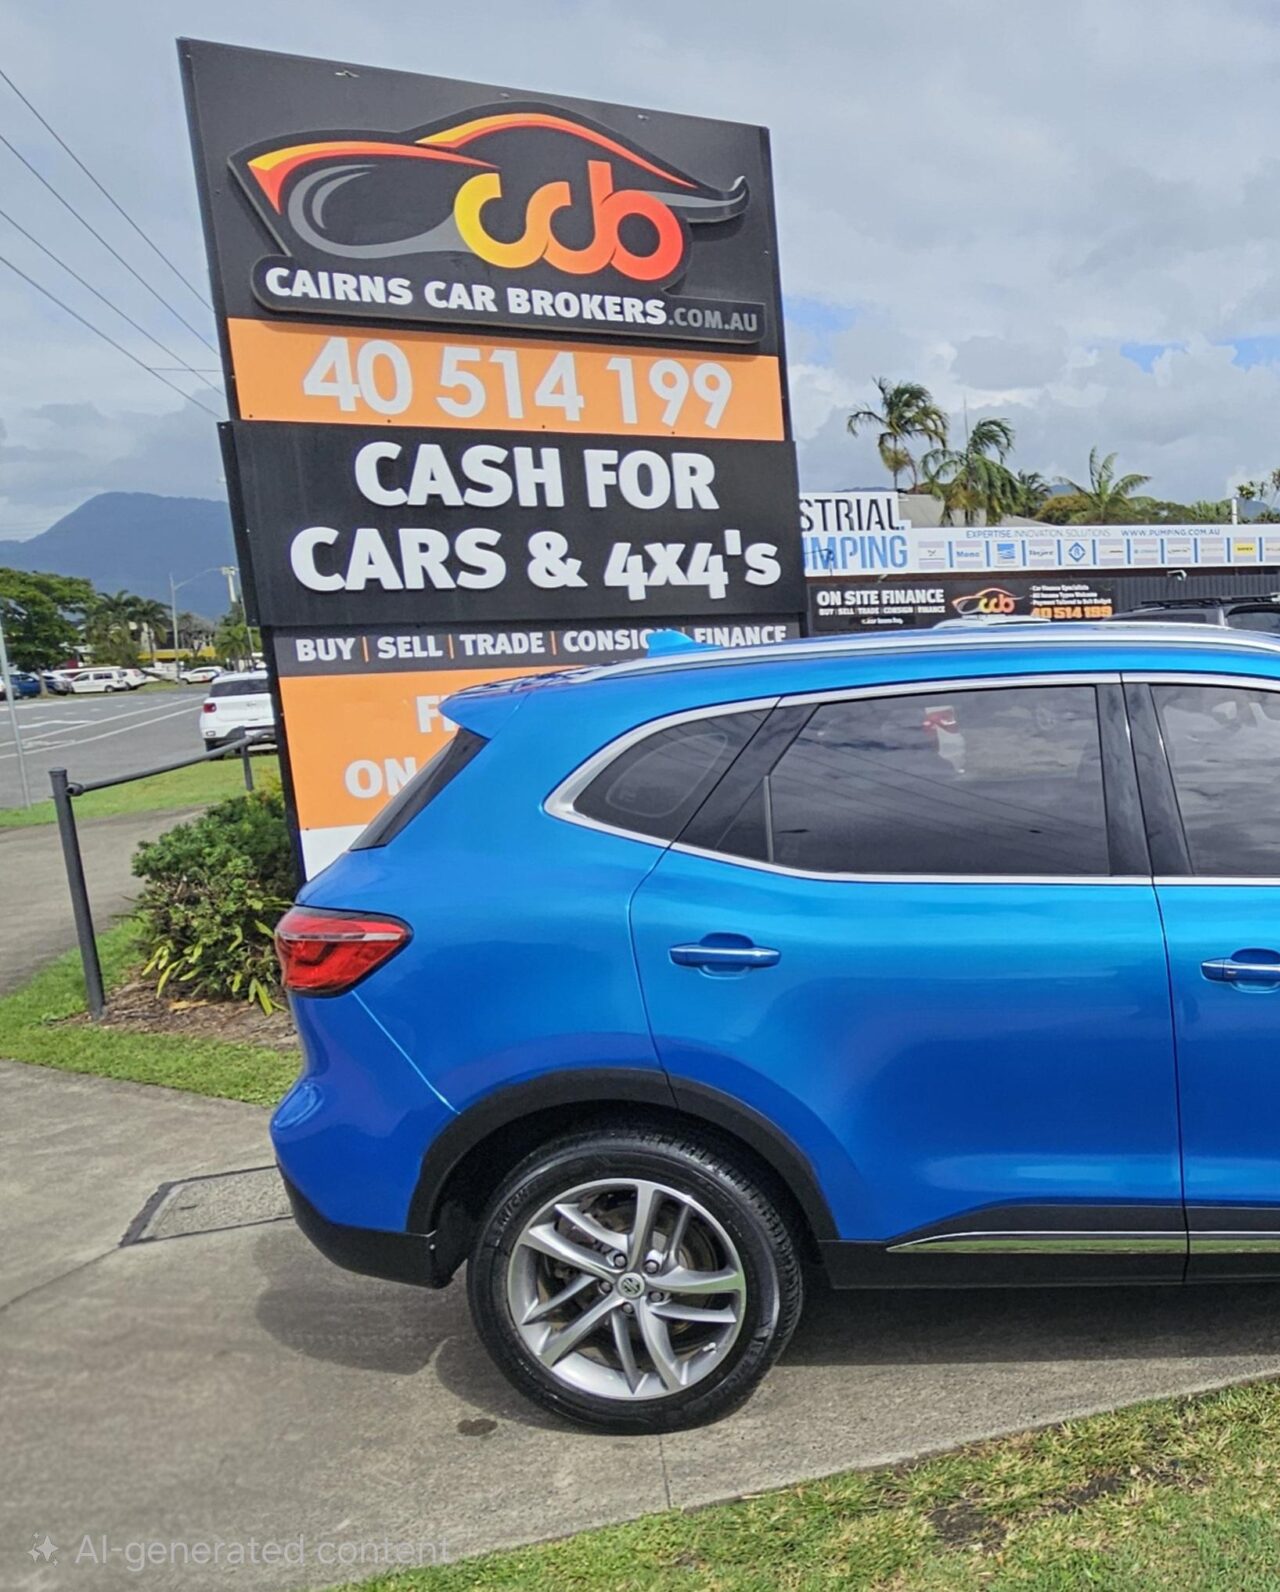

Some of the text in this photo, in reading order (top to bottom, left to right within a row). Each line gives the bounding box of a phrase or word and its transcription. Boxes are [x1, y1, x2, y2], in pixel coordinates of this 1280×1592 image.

[265, 267, 413, 305] CAIRNS
[424, 281, 498, 312] CAR
[303, 337, 733, 429] 40 514 199
[355, 441, 720, 510] CASH FOR
[290, 526, 507, 592] CARS
[526, 530, 588, 588] &
[817, 589, 945, 606] ON SITE FINANCE
[1053, 606, 1082, 619] 514
[295, 637, 356, 663] BUY
[377, 632, 443, 659] SELL
[460, 631, 546, 657] TRADE
[693, 625, 787, 648] FINANCE
